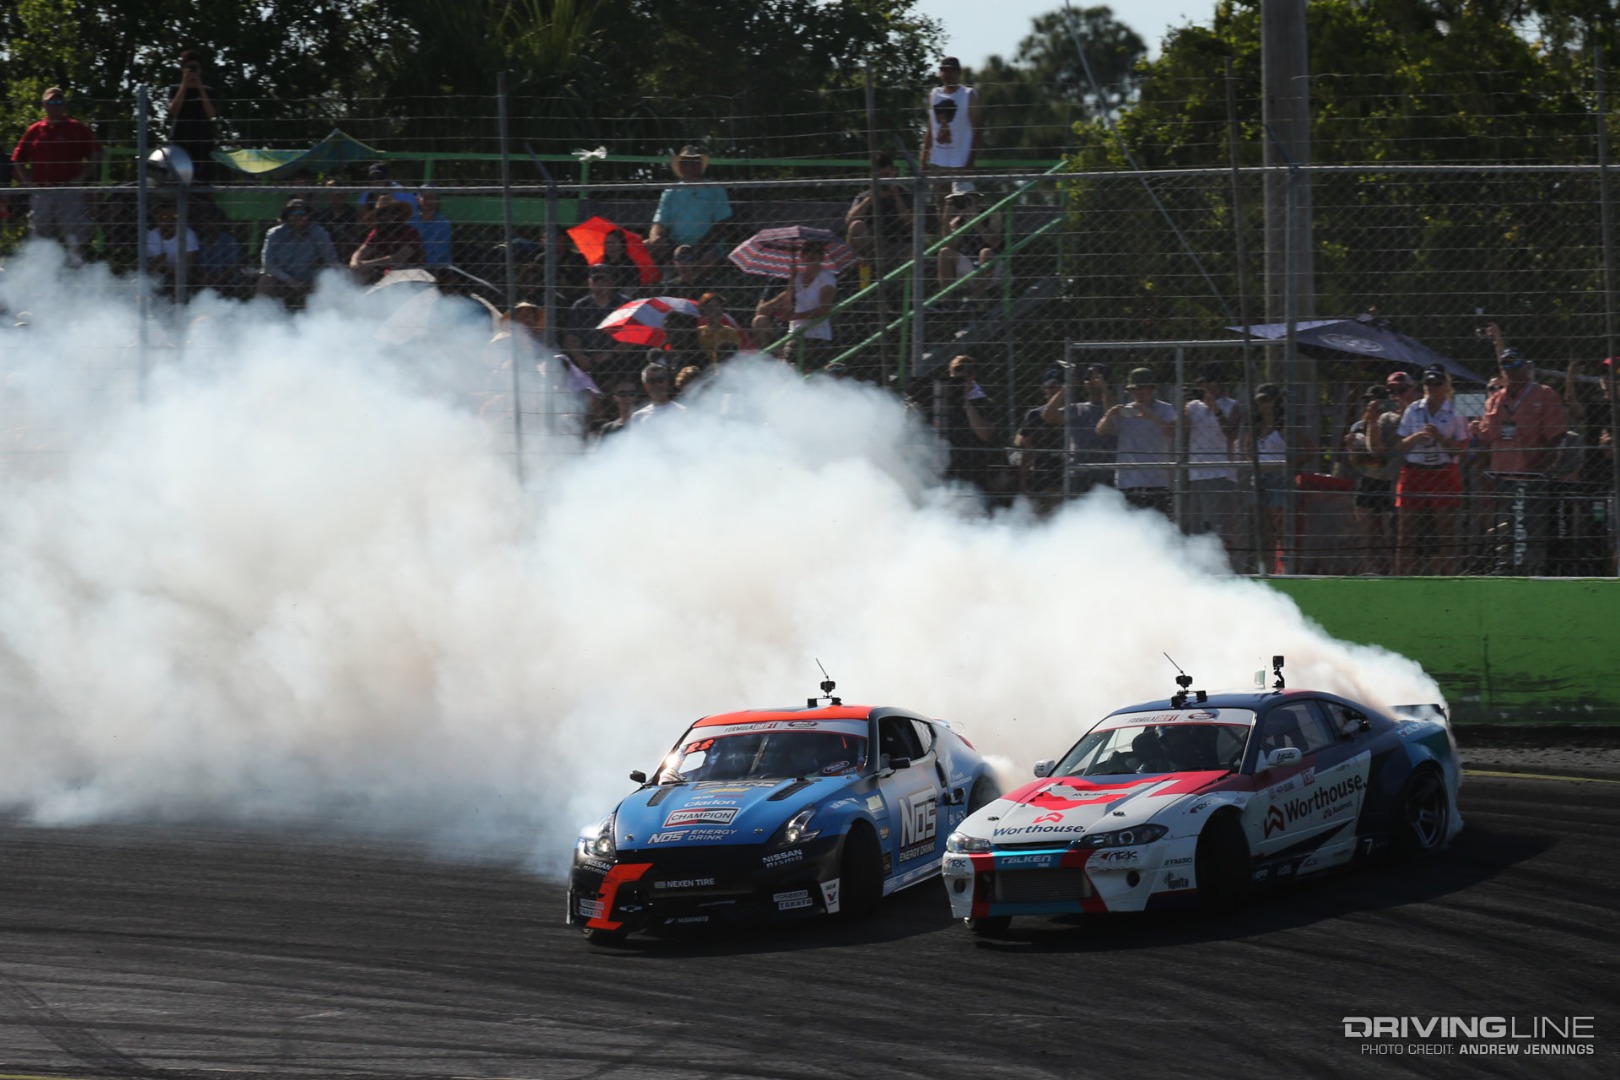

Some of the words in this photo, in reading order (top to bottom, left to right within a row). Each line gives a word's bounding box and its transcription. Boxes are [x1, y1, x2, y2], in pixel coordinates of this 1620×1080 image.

[724, 724, 753, 733] FORMULA
[754, 722, 778, 730] DRIFT
[1284, 774, 1368, 823] Worthouse.
[671, 812, 732, 821] CHAMPION
[899, 785, 937, 848] NOS
[647, 829, 690, 844] NOS
[993, 824, 1086, 837] Worthouse.
[762, 849, 803, 863] NISSAN
[899, 848, 920, 862] ENERGY
[920, 842, 935, 855] DRINK
[585, 859, 612, 871] NISSAN
[1001, 855, 1052, 865] FALKEN
[666, 879, 694, 888] NEXEN
[695, 877, 715, 886] TIRE
[780, 898, 812, 909] TAKATA
